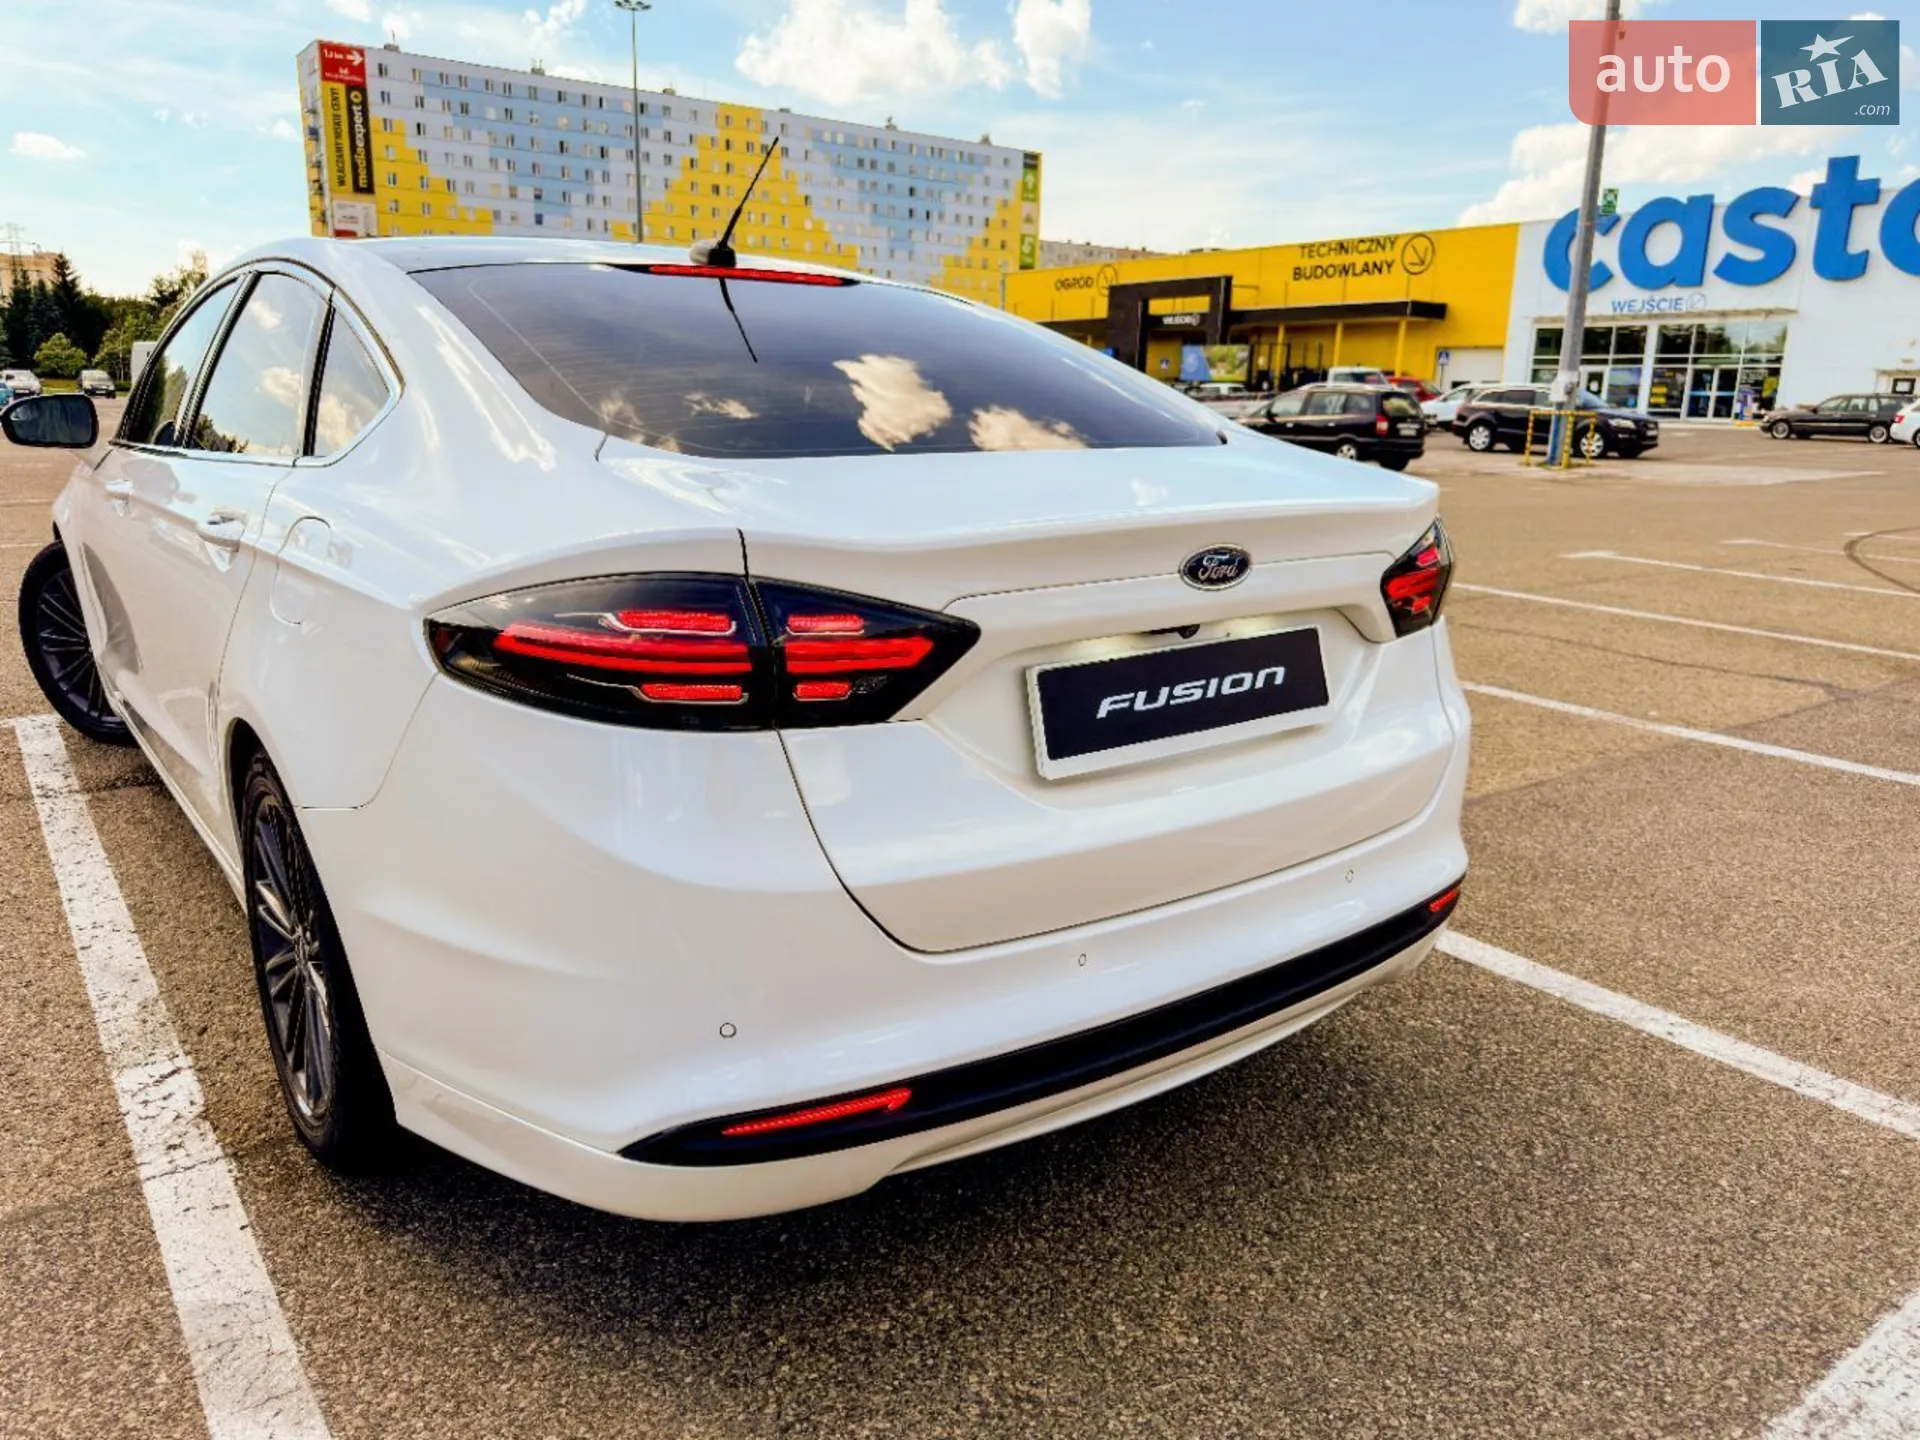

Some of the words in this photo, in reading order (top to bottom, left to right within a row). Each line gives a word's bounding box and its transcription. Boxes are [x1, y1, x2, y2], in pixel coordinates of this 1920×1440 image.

[1299, 235, 1399, 258] TECHNICZNY
[1293, 259, 1395, 281] BUDOWLANY
[1611, 295, 1684, 313] WEJŚCIE
[1198, 554, 1240, 580] Ford
[1096, 665, 1285, 719] FUSION
